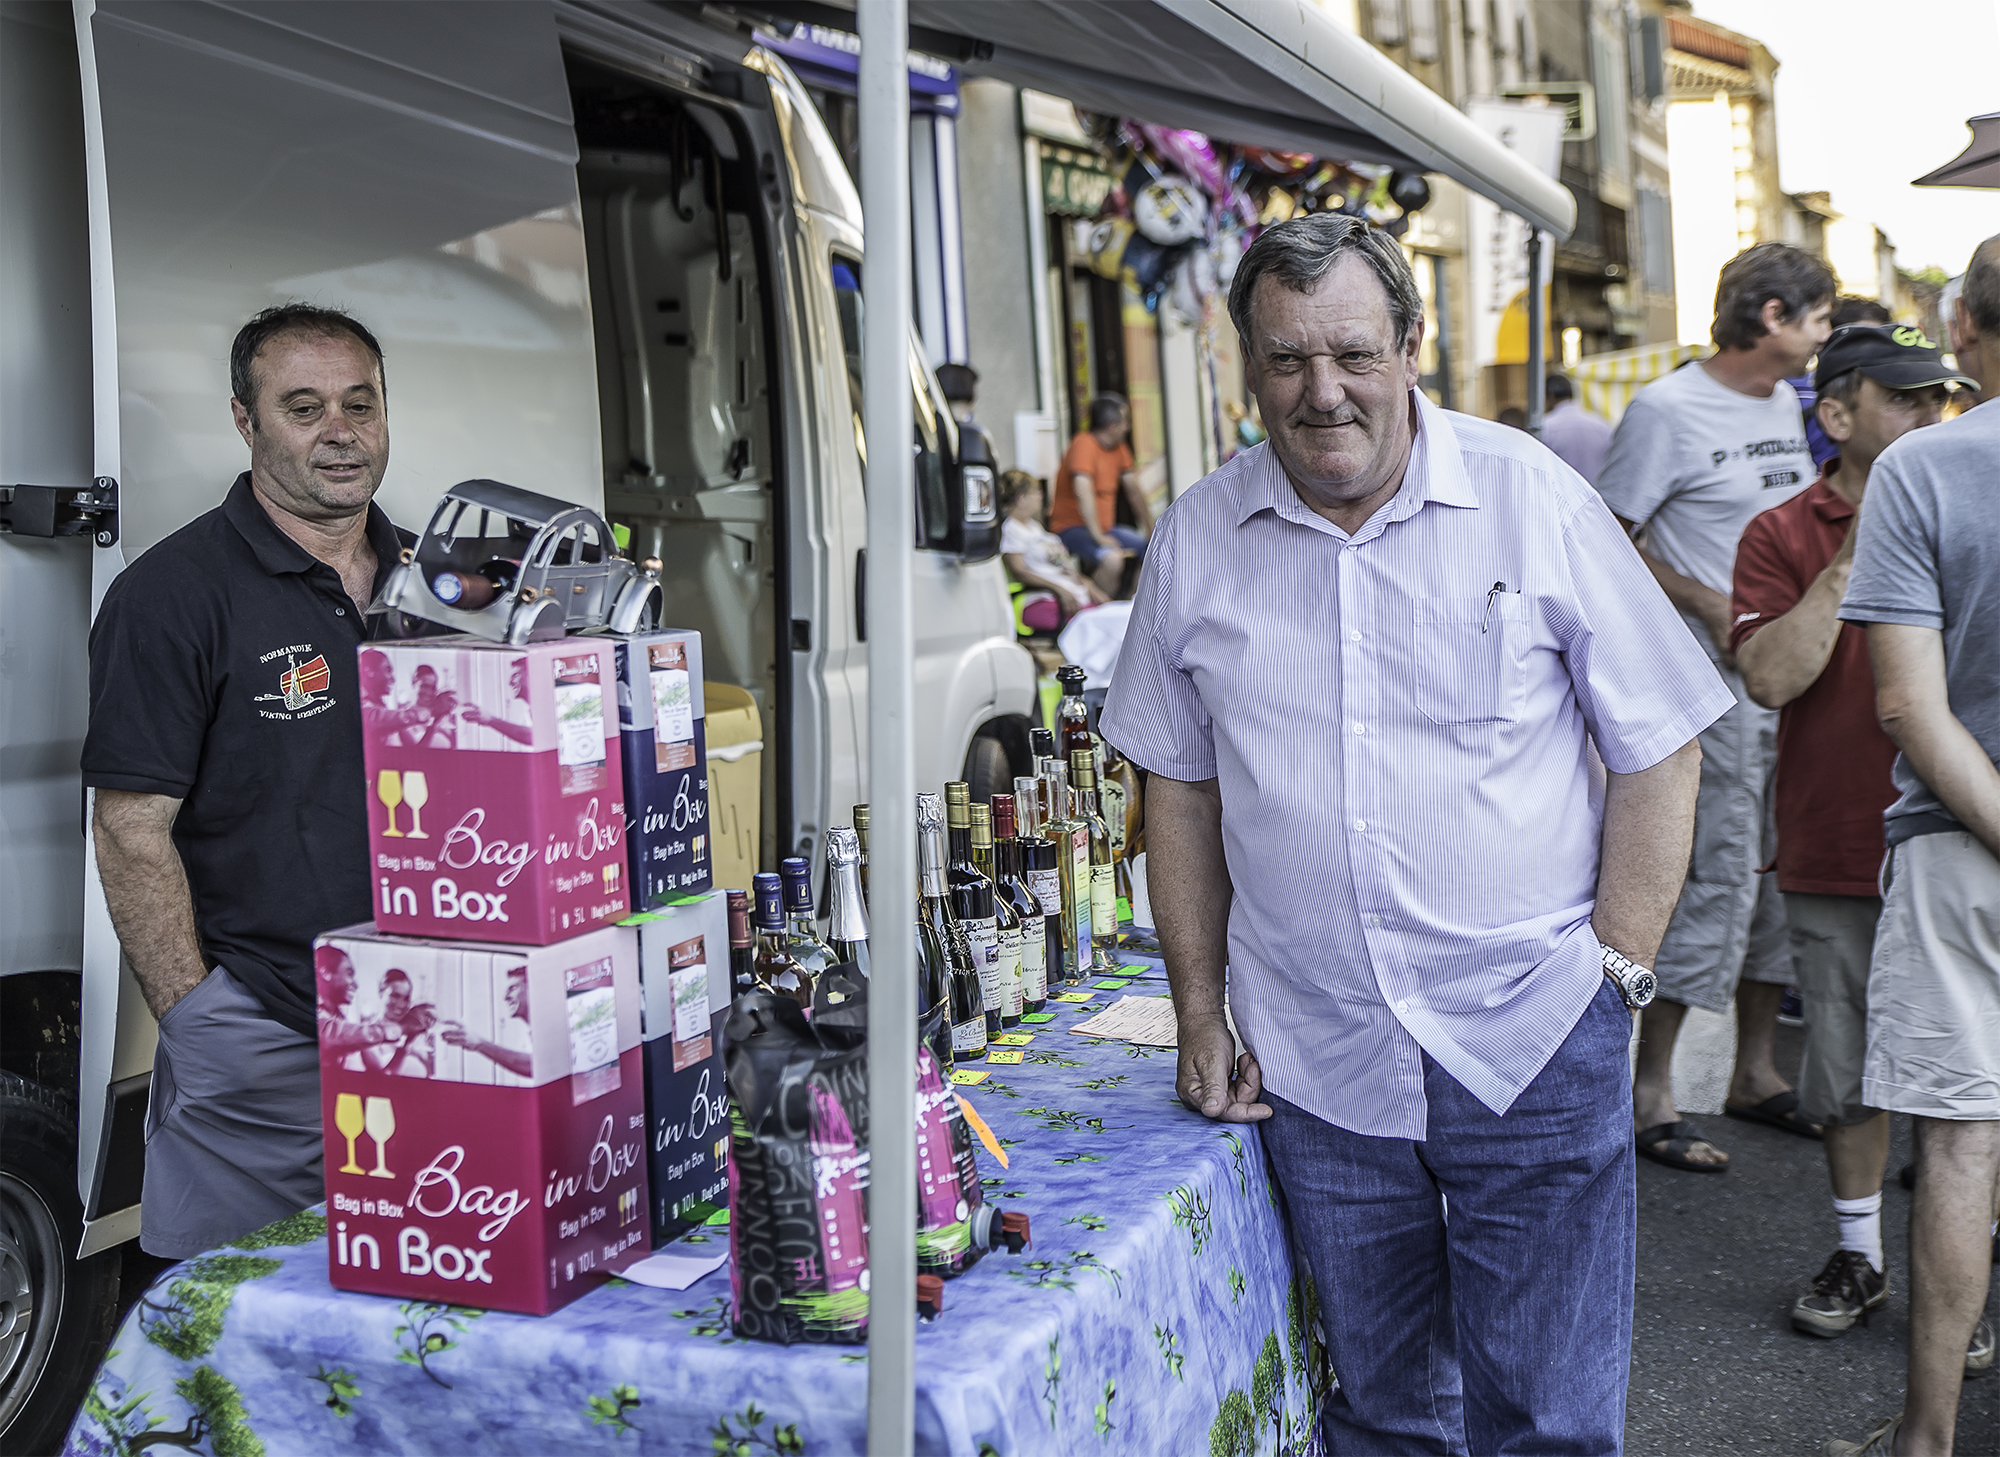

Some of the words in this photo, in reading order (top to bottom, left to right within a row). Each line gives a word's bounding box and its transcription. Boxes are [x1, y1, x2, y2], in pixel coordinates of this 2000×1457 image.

[259, 710, 292, 721] VIKING
[296, 698, 337, 720] HERITAGE
[643, 805, 670, 834] in
[670, 773, 707, 832] Box
[438, 807, 539, 888] Bag
[544, 833, 575, 865] in
[575, 797, 622, 861] Box
[377, 853, 400, 873] Bag
[402, 856, 413, 870] in
[413, 855, 437, 872] Box
[653, 845, 667, 861] Bag
[380, 877, 418, 917] in
[431, 877, 509, 923] Box
[655, 1117, 686, 1152] in
[688, 1068, 730, 1140] Box
[543, 1169, 582, 1208] in
[584, 1114, 641, 1193] Box
[667, 1164, 684, 1181] Bag
[691, 1152, 705, 1168] Box
[407, 1144, 530, 1242] Bag
[720, 1177, 730, 1191] Bo
[333, 1193, 361, 1216] Bag
[362, 1196, 376, 1214] in
[377, 1199, 405, 1218] Box
[559, 1220, 579, 1239] Bag
[590, 1206, 607, 1224] Box
[336, 1221, 381, 1270] in
[397, 1225, 493, 1284] Box
[602, 1245, 618, 1261] Bag
[627, 1230, 642, 1247] Box
